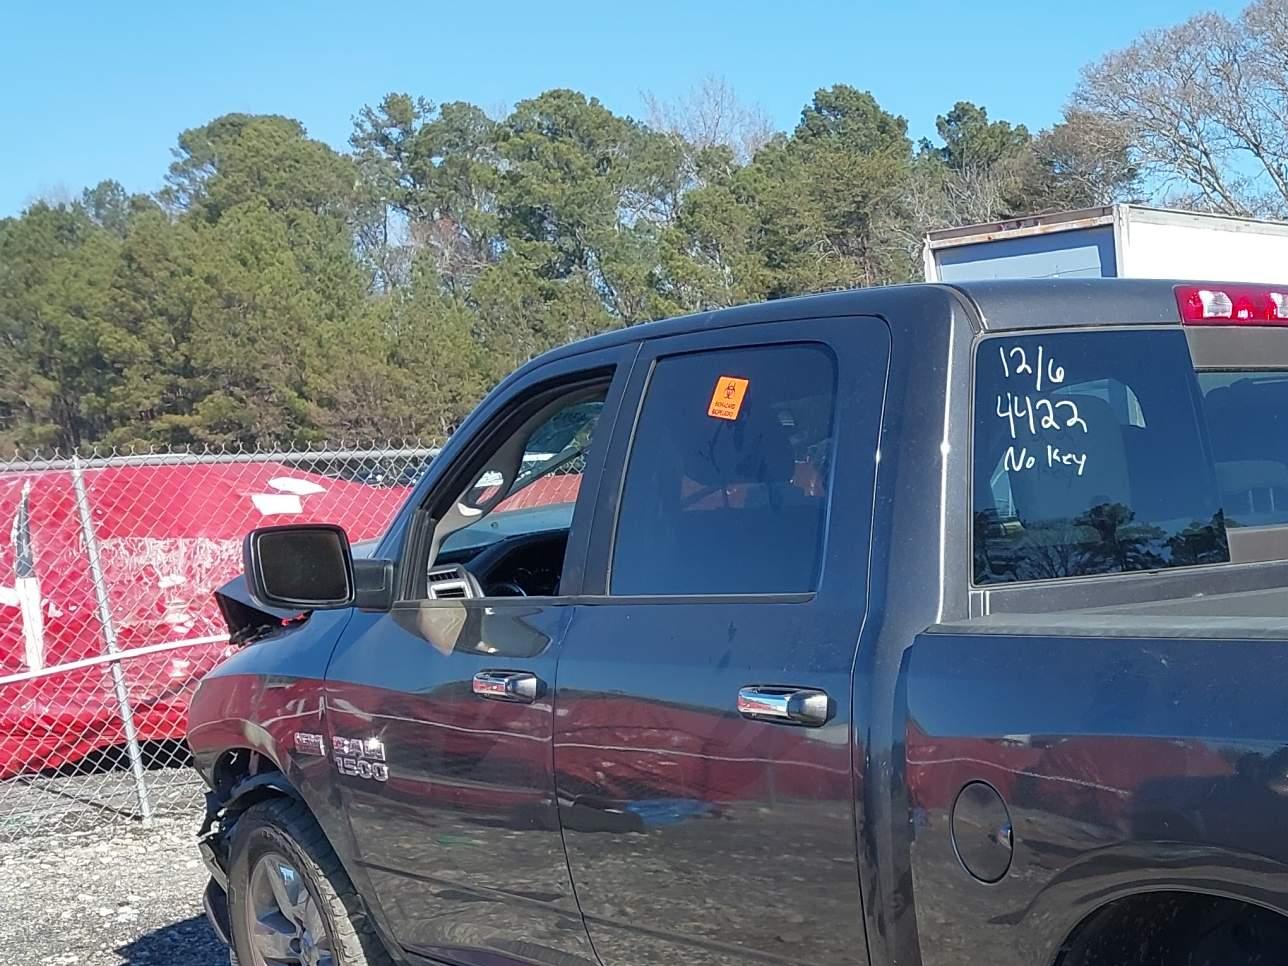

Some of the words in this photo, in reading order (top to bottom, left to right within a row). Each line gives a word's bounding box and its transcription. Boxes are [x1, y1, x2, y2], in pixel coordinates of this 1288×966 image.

[999, 345, 1066, 391] 12/6
[996, 392, 1088, 440] 4422
[1004, 446, 1036, 472] No
[332, 736, 386, 761] RAM
[335, 756, 389, 782] 1500
